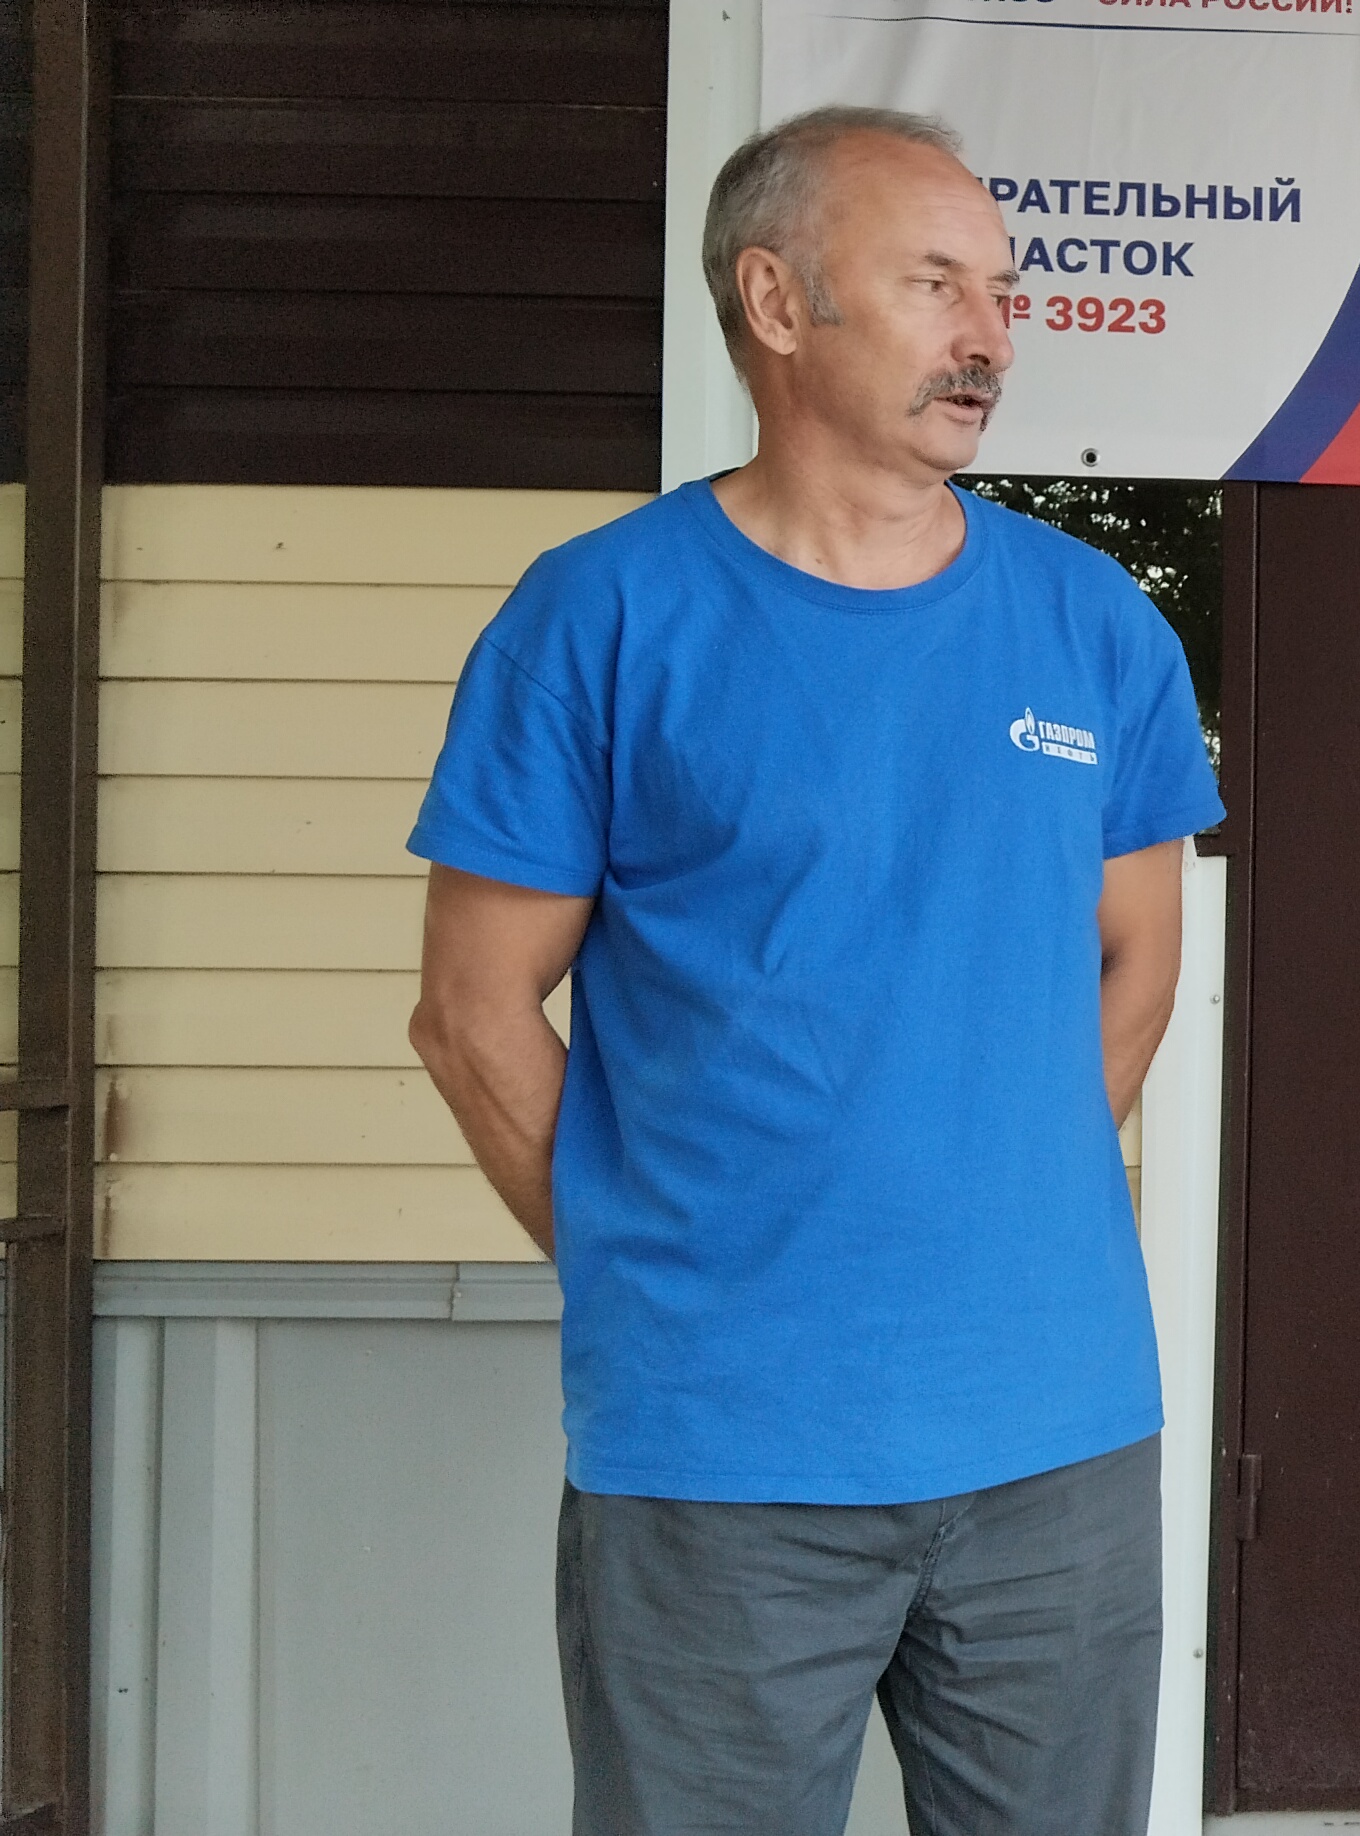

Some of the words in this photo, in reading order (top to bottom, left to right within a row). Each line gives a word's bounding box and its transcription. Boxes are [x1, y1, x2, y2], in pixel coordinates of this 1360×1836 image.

[978, 177, 1301, 222] РАТЕЛЬНЫЙ
[1045, 295, 1166, 334] 3923
[1039, 721, 1096, 750] ГАЗПРОМ
